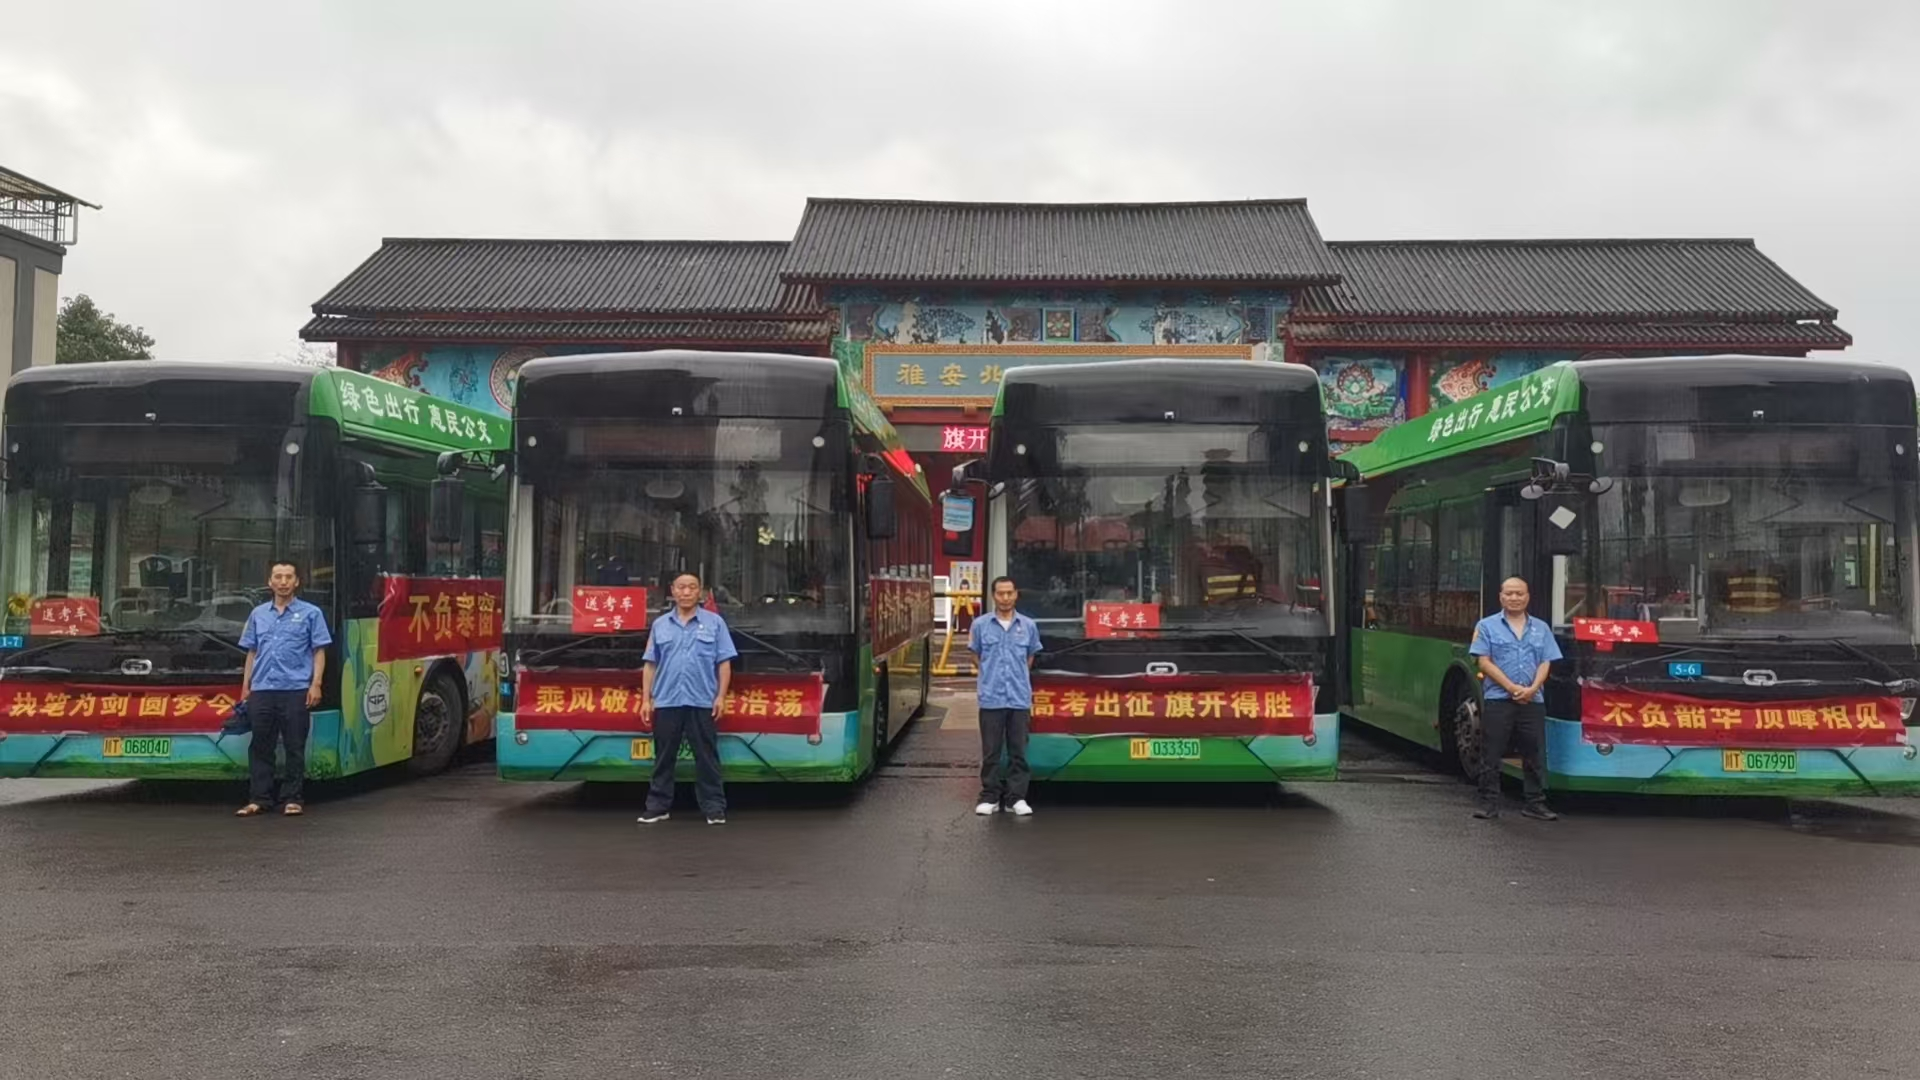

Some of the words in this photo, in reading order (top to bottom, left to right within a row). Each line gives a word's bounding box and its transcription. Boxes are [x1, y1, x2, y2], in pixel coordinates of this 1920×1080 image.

[340, 379, 419, 425] 绿色出行
[428, 404, 492, 444] 惠民公交
[1427, 403, 1484, 443] 绿色出行
[1485, 376, 1555, 424] 惠民公交
[943, 427, 988, 449] 旗开
[42, 606, 87, 622] 送考车
[585, 595, 633, 612] 送考车
[408, 592, 502, 643] 不负寒窗
[593, 615, 624, 630] 二号
[1098, 611, 1147, 628] 送考车
[1589, 624, 1643, 638] 送考车
[1675, 665, 1696, 675] 5-6
[9, 692, 131, 718] 执笔为剑
[1030, 690, 1155, 717] 高考出征
[1165, 690, 1294, 718] 旗开得胜
[1602, 701, 1743, 730] 不负韶华
